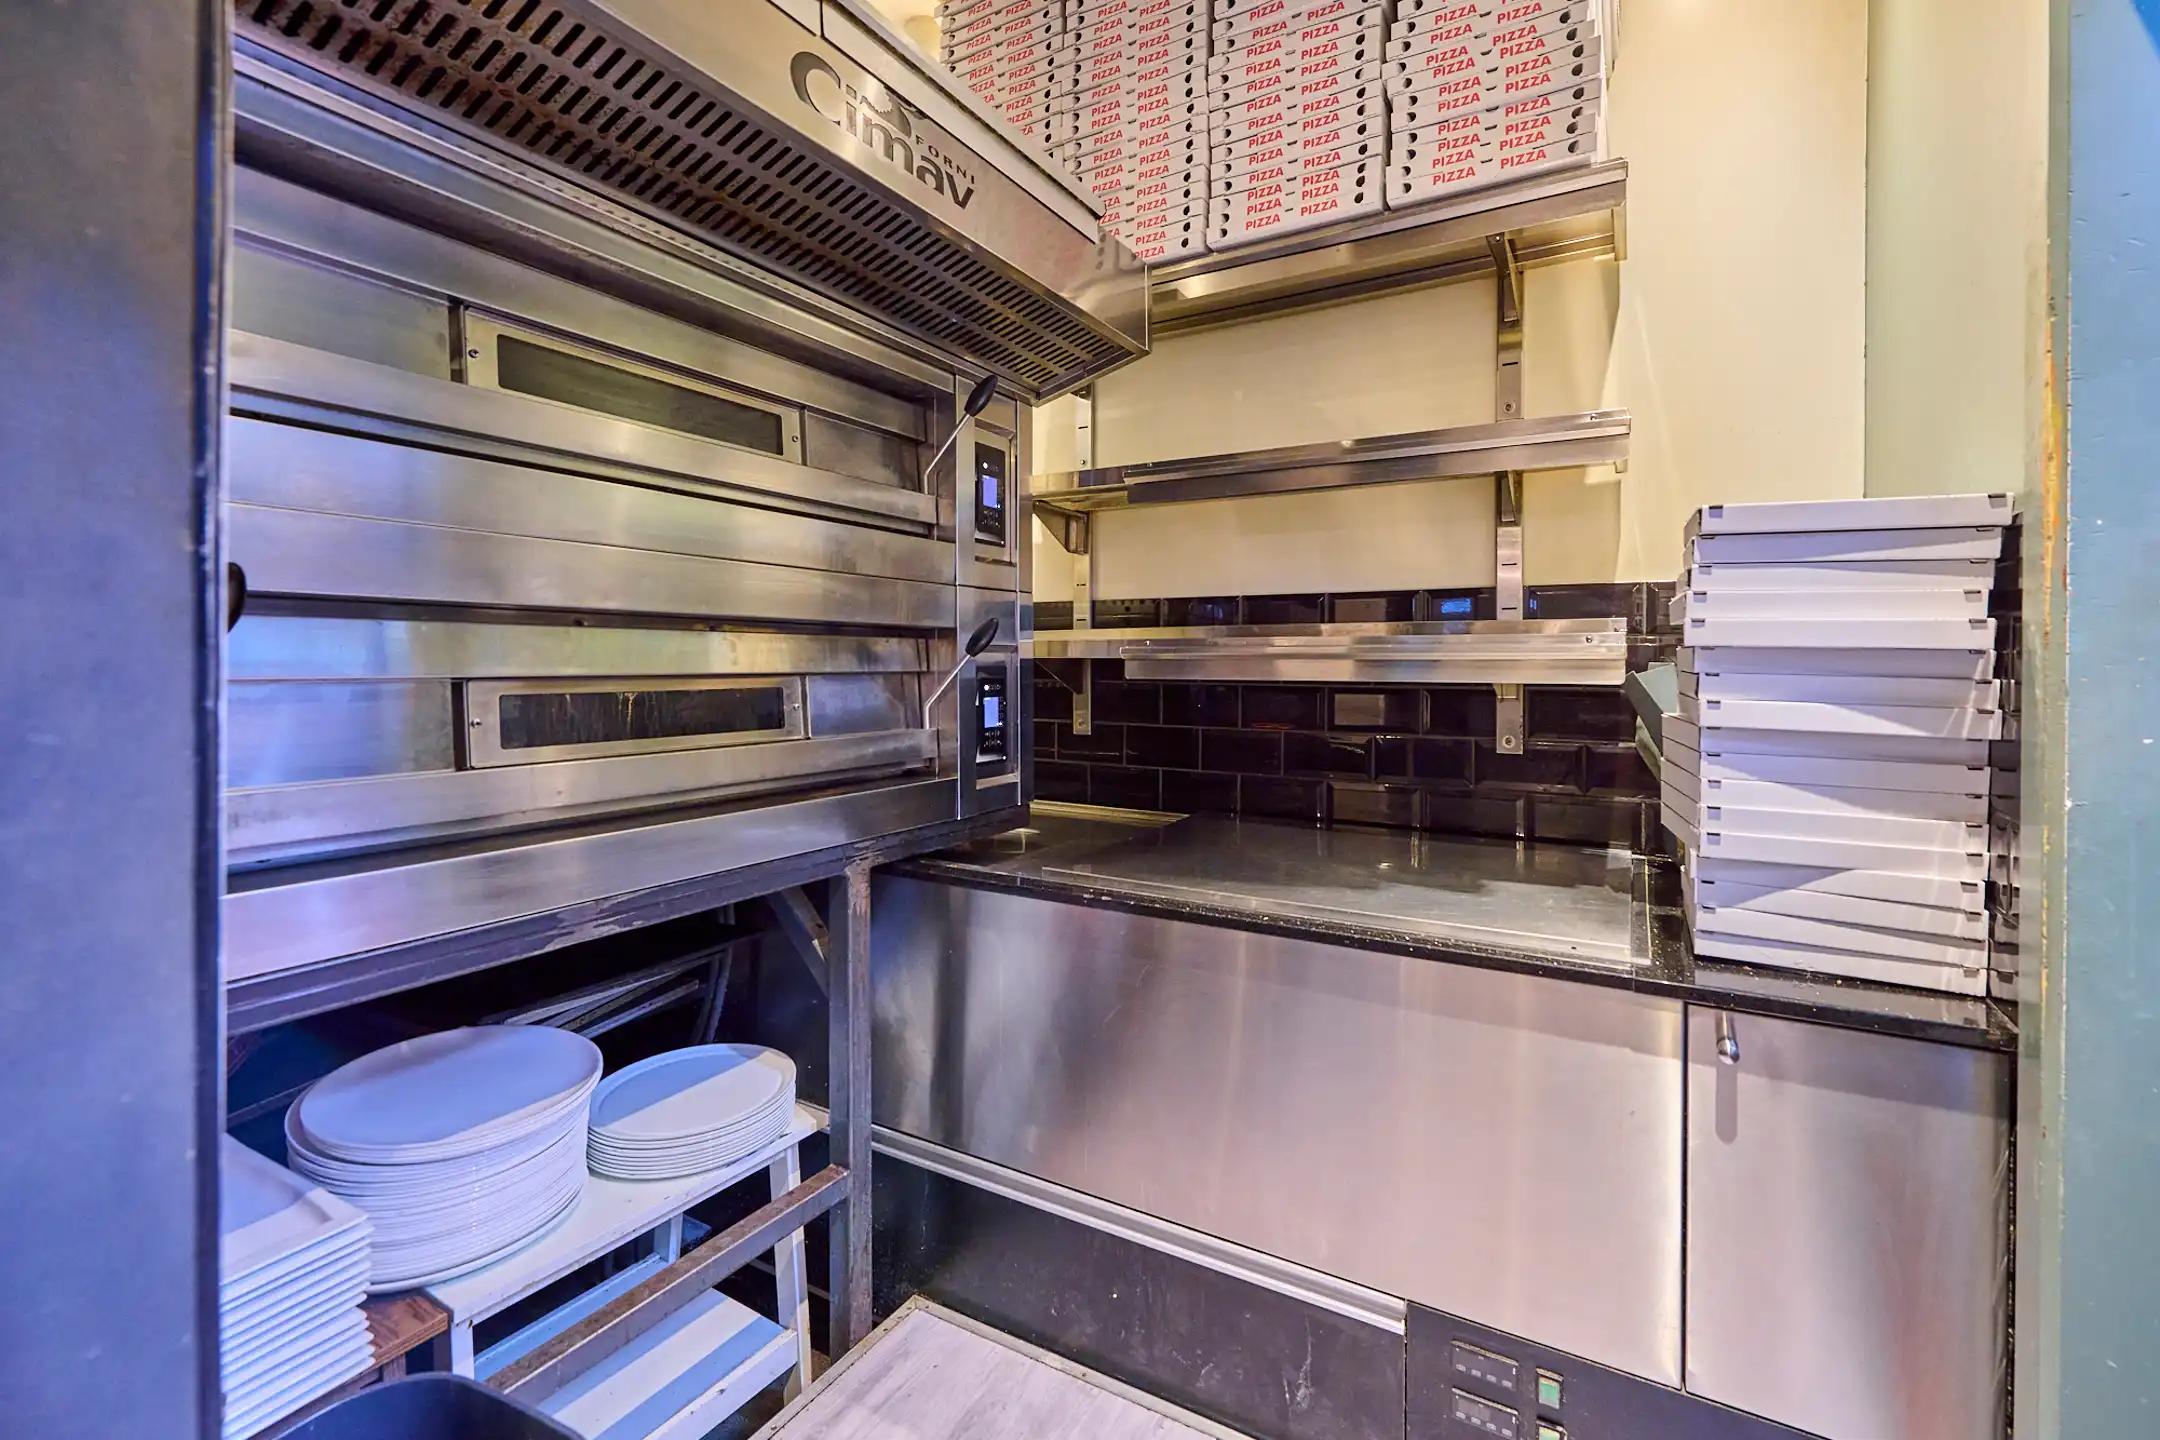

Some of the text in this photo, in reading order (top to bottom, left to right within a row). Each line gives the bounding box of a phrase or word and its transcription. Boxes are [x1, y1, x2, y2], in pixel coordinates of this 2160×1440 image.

[967, 0, 1032, 33] PIZZA PIZZA
[968, 0, 992, 16] PIZZA
[1094, 0, 1170, 34] PIZZA PIZZA
[1098, 1, 1127, 17] PIZZA
[1249, 1, 1285, 21] PIZZA
[1252, 1, 1345, 41] PIZZA PIZZA
[1430, 3, 1543, 44] PIZZA PIZZA
[1435, 4, 1479, 25] PIZZA
[967, 17, 1031, 49] PIZZA PIZZA
[968, 33, 1033, 64] PIZZA PIZZA
[1093, 17, 1169, 49] PIZZA PIZZA
[1247, 23, 1339, 57] PIZZA PIZZA
[1426, 24, 1537, 66] PIZZA PIZZA
[969, 48, 1035, 80] PIZZA PIZZA
[1092, 49, 1169, 81] PIZZA PIZZA
[1094, 32, 1169, 67] PIZZA PIZZA
[1246, 41, 1338, 76] PIZZA PIZZA
[1433, 37, 1545, 79] PIZZA PIZZA
[1009, 64, 1035, 80] PIZZA
[1009, 80, 1036, 95] PIZZA
[1092, 66, 1168, 100] PIZZA PIZZA
[1247, 57, 1338, 93] PIZZA PIZZA
[1439, 56, 1551, 97] PIZZA PIZZA
[1006, 96, 1032, 112] PIZZA
[1092, 84, 1168, 117] PIZZA PIZZA
[1247, 77, 1338, 112] PIZZA PIZZA
[1438, 73, 1551, 112] PIZZA PIZZA
[1092, 97, 1168, 128] PIZZA PIZZA
[1248, 96, 1339, 130] PIZZA PIZZA
[1438, 97, 1551, 136] PIZZA PIZZA
[1094, 113, 1170, 145] PIZZA PIZZA
[1248, 112, 1340, 148] PIZZA PIZZA
[1438, 116, 1551, 152] PIZZA PIZZA
[915, 134, 975, 184] FORNI
[1094, 132, 1169, 164] PIZZA PIZZA
[1248, 130, 1340, 165] PIZZA PIZZA
[1432, 130, 1545, 169] PIZZA PIZZA
[1092, 165, 1169, 193] PIZZA PIZZA
[1095, 149, 1170, 180] PIZZA PIZZA
[1249, 151, 1341, 184] PIZZA PIZZA
[1433, 149, 1547, 184] PIZZA PIZZA
[1137, 182, 1167, 197] PIZZA
[1247, 168, 1340, 200] PIZZA PIZZA
[1247, 183, 1339, 215] PIZZA PIZZA
[1137, 198, 1167, 213] PIZZA
[1246, 199, 1338, 230] PIZZA PIZZA
[1136, 231, 1166, 245] PIZZA
[1137, 216, 1167, 229] PIZZA
